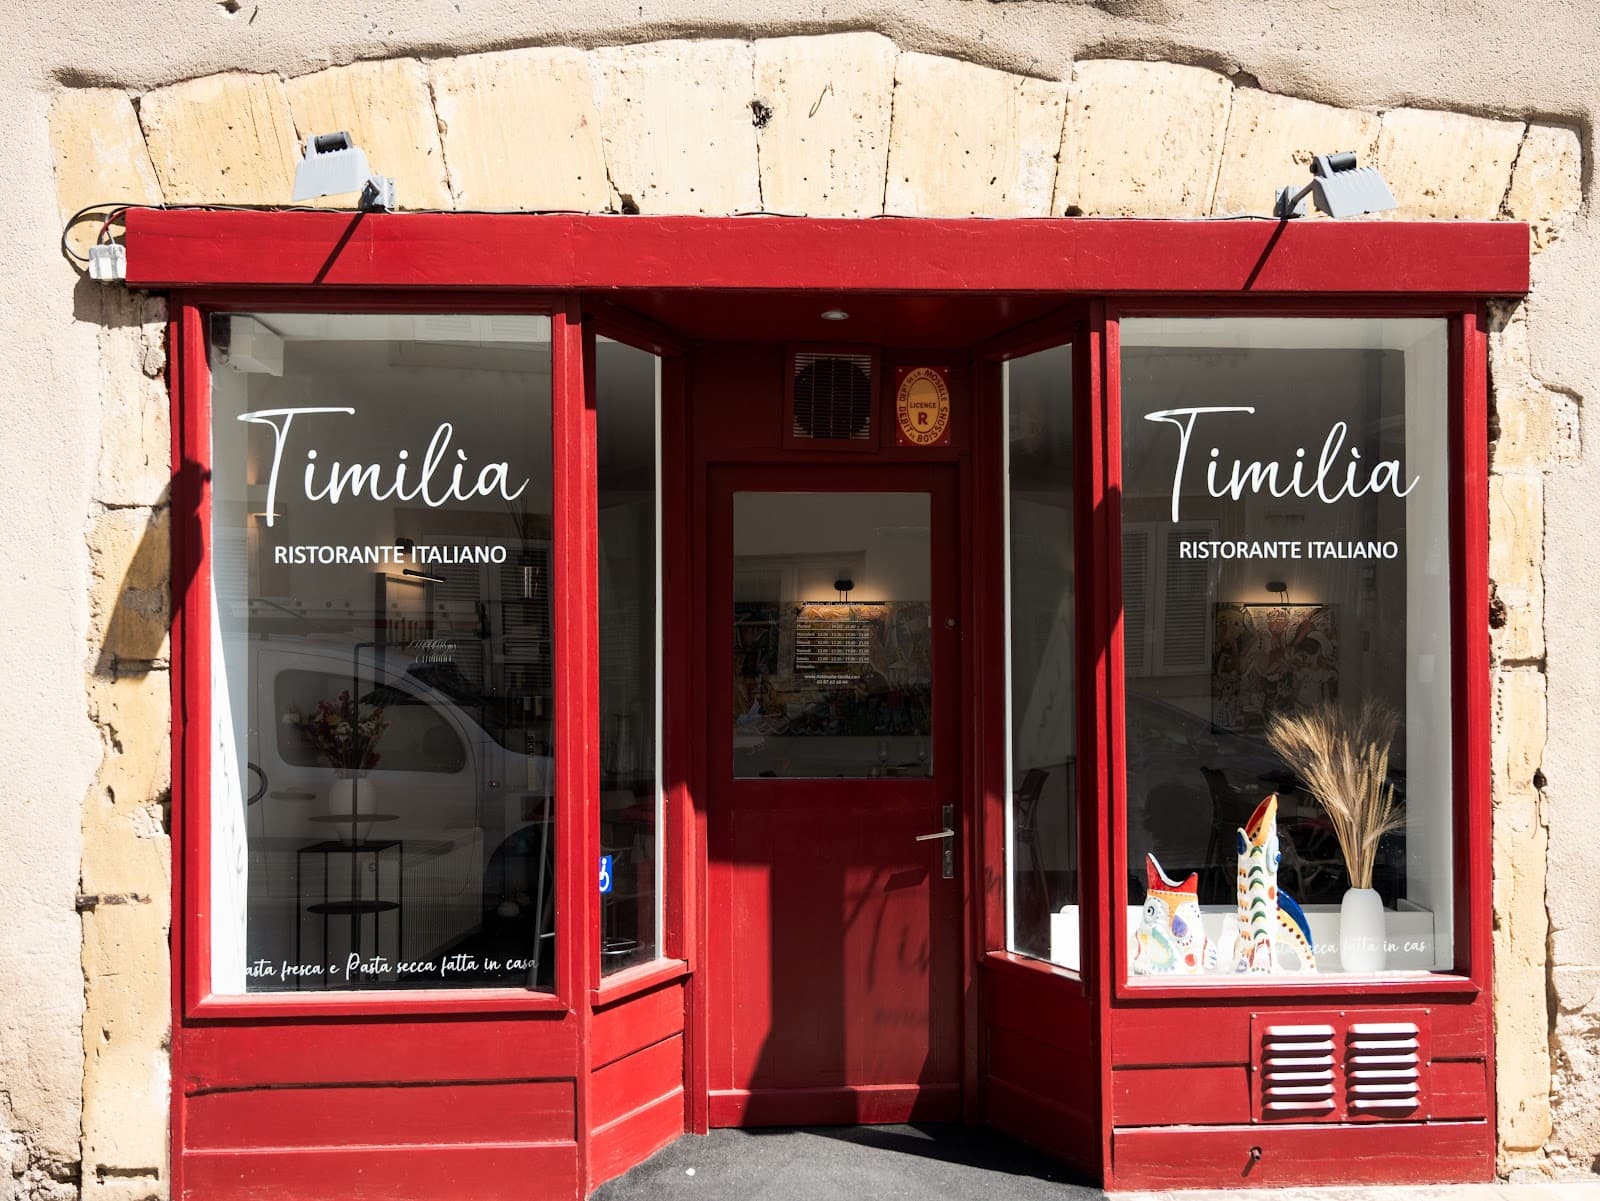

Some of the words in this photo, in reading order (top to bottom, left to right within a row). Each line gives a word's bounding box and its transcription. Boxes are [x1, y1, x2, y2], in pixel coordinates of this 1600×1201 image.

[924, 369, 949, 402] MOSELLE
[916, 406, 949, 443] BOISSONS
[917, 411, 929, 426] R
[237, 407, 530, 527] Timilìa
[1144, 406, 1420, 524] Timilìa
[274, 545, 404, 564] RISTORANTE
[411, 545, 507, 564] ITALIANO
[1179, 541, 1301, 559] RISTORANTE
[1308, 541, 1398, 559] ITALIANO
[1383, 940, 1399, 953] in
[1403, 940, 1426, 953] cas
[245, 958, 277, 977] asta
[281, 960, 325, 982] fresca
[329, 963, 341, 974] e
[346, 952, 392, 981] Pasta
[396, 960, 437, 973] secca
[440, 953, 479, 977] fatta
[484, 957, 501, 971] in
[505, 958, 540, 970] casa
